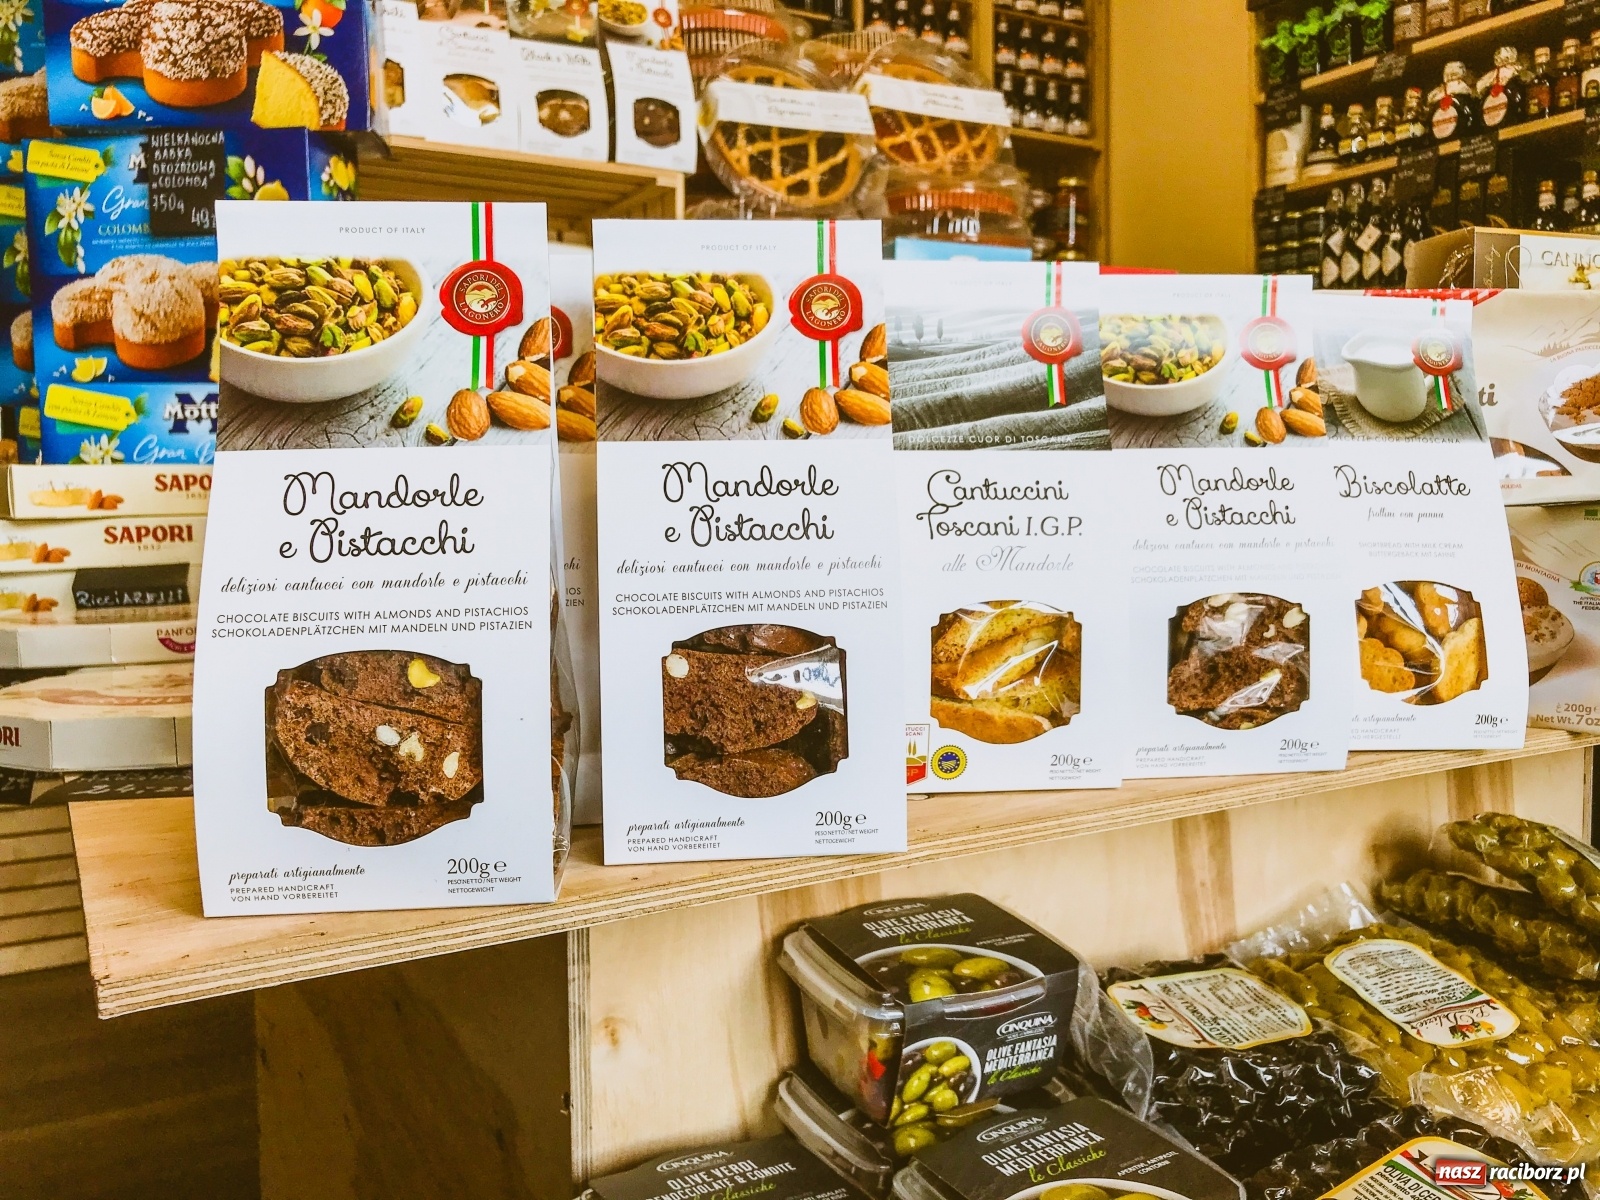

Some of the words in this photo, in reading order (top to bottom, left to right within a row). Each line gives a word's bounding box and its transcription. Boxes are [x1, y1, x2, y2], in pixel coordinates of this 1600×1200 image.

[151, 131, 225, 147] WIELKANOCNA
[98, 223, 150, 236] COLOMB
[339, 226, 384, 234] PRODUCT
[387, 226, 399, 234] OF
[402, 226, 426, 234] ITALY
[701, 243, 740, 251] PRODUCT
[743, 243, 753, 251] OF
[755, 243, 777, 251] ITALY
[1541, 250, 1600, 271] CANNO
[459, 274, 488, 294] SAPORI
[490, 277, 504, 294] DEL
[459, 301, 505, 321] LAGONERO
[805, 308, 847, 327] LAGONERO
[164, 402, 218, 421] Mott
[908, 434, 966, 444] DOLCEZZE
[969, 434, 1002, 443] CUOR
[1005, 434, 1018, 443] DI
[1020, 433, 1074, 443] TOSCANA
[133, 434, 187, 465] Gran
[155, 473, 212, 492] SAPO
[661, 461, 840, 503] Mandorle
[927, 469, 1070, 508] Cantuccini
[1157, 464, 1296, 496] Mandorle
[1333, 463, 1471, 499] Biscolatte
[283, 471, 485, 516] Mandorle
[916, 503, 1020, 540] Toscani
[1025, 516, 1083, 537] I.G.P.
[1166, 513, 1179, 527] e
[1183, 496, 1296, 530] Pistacchi
[1399, 511, 1414, 520] con
[1417, 511, 1445, 523] panna
[103, 524, 194, 545] SAPORI
[664, 525, 681, 543] e
[689, 504, 835, 548] Pistacchi
[279, 541, 298, 559] e
[309, 517, 475, 564] Pistacchi
[1174, 540, 1215, 551] cantucci
[1218, 542, 1235, 550] con
[1239, 538, 1282, 549] mandorle
[1404, 541, 1420, 549] WITH
[1438, 542, 1464, 550] CREAM
[942, 555, 967, 573] alle
[975, 545, 1074, 573] Mandorle
[1433, 551, 1456, 559] SAHNE
[616, 558, 667, 577] deliziosi
[672, 558, 725, 574] cantucci
[730, 561, 750, 572] con
[756, 556, 812, 572] mandorle
[818, 562, 825, 571] e
[827, 555, 884, 576] pistacchi
[1132, 565, 1182, 575] CHOCOLATE
[1183, 564, 1216, 573] BISCUITS
[1217, 563, 1236, 572] WITH
[1524, 564, 1560, 583] MONTAGNA
[220, 575, 278, 595] deliziosi
[284, 575, 345, 592] cantucci
[351, 578, 375, 591] con
[382, 571, 446, 590] mandorle
[453, 578, 461, 587] e
[464, 570, 529, 595] pistacchi
[615, 592, 680, 603] CHOCOLATE
[682, 591, 723, 602] BISCUITS
[725, 590, 750, 600] WITH
[752, 589, 802, 600] ALMONDS
[804, 588, 827, 598] AND
[829, 587, 885, 598] PISTACHIOS
[216, 611, 290, 624] CHOCOLATE
[292, 610, 341, 623] BISCUITS
[344, 609, 370, 621] WITH
[373, 608, 432, 620] ALMONDS
[434, 607, 461, 618] AND
[464, 605, 529, 617] PISTACHIOS
[612, 602, 746, 616] SCHOKOLADENPLÄTZCHEN
[747, 602, 765, 612] MIT
[767, 601, 816, 612] MANDELN
[818, 601, 840, 611] UND
[842, 600, 888, 610] PISTAZIEN
[210, 622, 366, 639] SCHOKOLADENPLÄTZCHEN
[369, 623, 388, 635] MIT
[391, 622, 448, 634] MANDELN
[451, 621, 476, 632] UND
[478, 620, 533, 631] PISTAZIEN
[1564, 703, 1592, 715] 200g
[1474, 713, 1499, 728] 200g
[1536, 714, 1555, 724] Net
[1557, 715, 1575, 726] Wt.
[1576, 714, 1584, 725] 7
[1279, 738, 1309, 753] 200g
[1049, 754, 1082, 770] 200g
[627, 820, 672, 836] preparati
[674, 816, 746, 833] artigianalmente
[814, 811, 852, 830] 200g
[627, 837, 666, 845] PREPARED
[668, 835, 718, 844] HANDICRAFT
[627, 845, 645, 853] VON
[647, 844, 670, 852] HAND
[672, 842, 721, 851] VORBEREITET
[229, 867, 279, 885] preparati
[283, 864, 366, 882] artigianalmente
[447, 857, 490, 878] 200g
[230, 885, 275, 895] PREPARED
[277, 883, 335, 893] HANDICRAFT
[462, 877, 483, 885] NETTO
[499, 876, 522, 884] WEIGHT
[230, 893, 250, 903] VON
[254, 892, 280, 902] HAND
[283, 891, 339, 901] VORBEREITET
[862, 915, 904, 932] OLIVE
[903, 907, 966, 927] FANTASIA
[872, 915, 975, 940] MEDITERRANEA
[1001, 1014, 1054, 1035] CINQUINA
[985, 1044, 1015, 1062] OLIVE
[1014, 1034, 1058, 1056] FANTASIA
[983, 1046, 1055, 1075] MEDITERRANEA
[982, 1116, 1043, 1142] CINQUINA
[980, 1143, 1024, 1167] OLIVE
[1020, 1121, 1091, 1154] FANTASIA
[662, 1150, 730, 1171] CINQUINA
[995, 1131, 1106, 1178] MEDITERRANEA
[1028, 1166, 1045, 1183] le
[1046, 1143, 1107, 1176] Classiche
[666, 1168, 714, 1192] OLIVE
[709, 1159, 759, 1180] VERDI
[736, 1173, 747, 1184] &
[749, 1161, 797, 1182] CONDITE
[1383, 1165, 1411, 1186] OLIVA
[1408, 1182, 1423, 1193] DI
[1375, 1171, 1393, 1184] peso
[1393, 1182, 1410, 1196] netto
